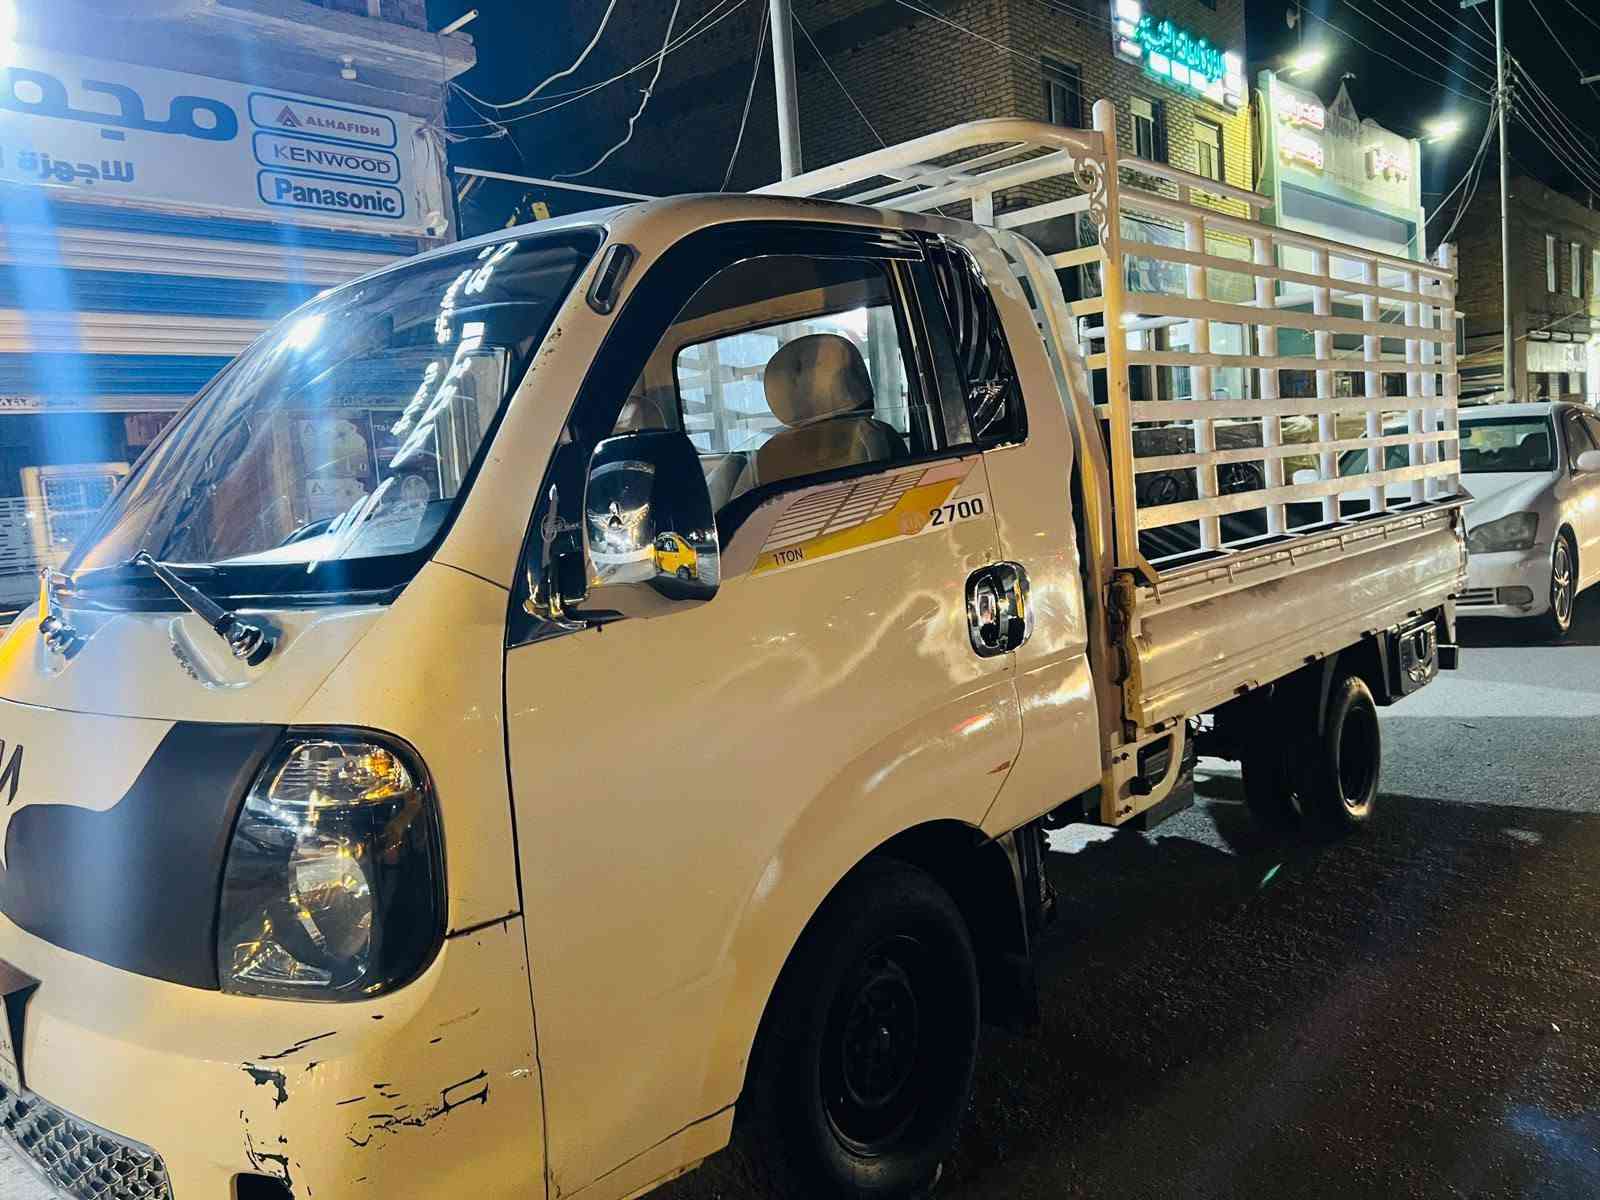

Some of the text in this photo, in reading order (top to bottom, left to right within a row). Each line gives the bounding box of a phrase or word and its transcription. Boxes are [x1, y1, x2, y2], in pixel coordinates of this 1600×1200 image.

[0, 67, 238, 141] مجم
[305, 116, 381, 137] ALHAFIDH
[274, 143, 391, 174] KENWOOD
[274, 177, 396, 213] Panasonic
[929, 497, 984, 527] 2700
